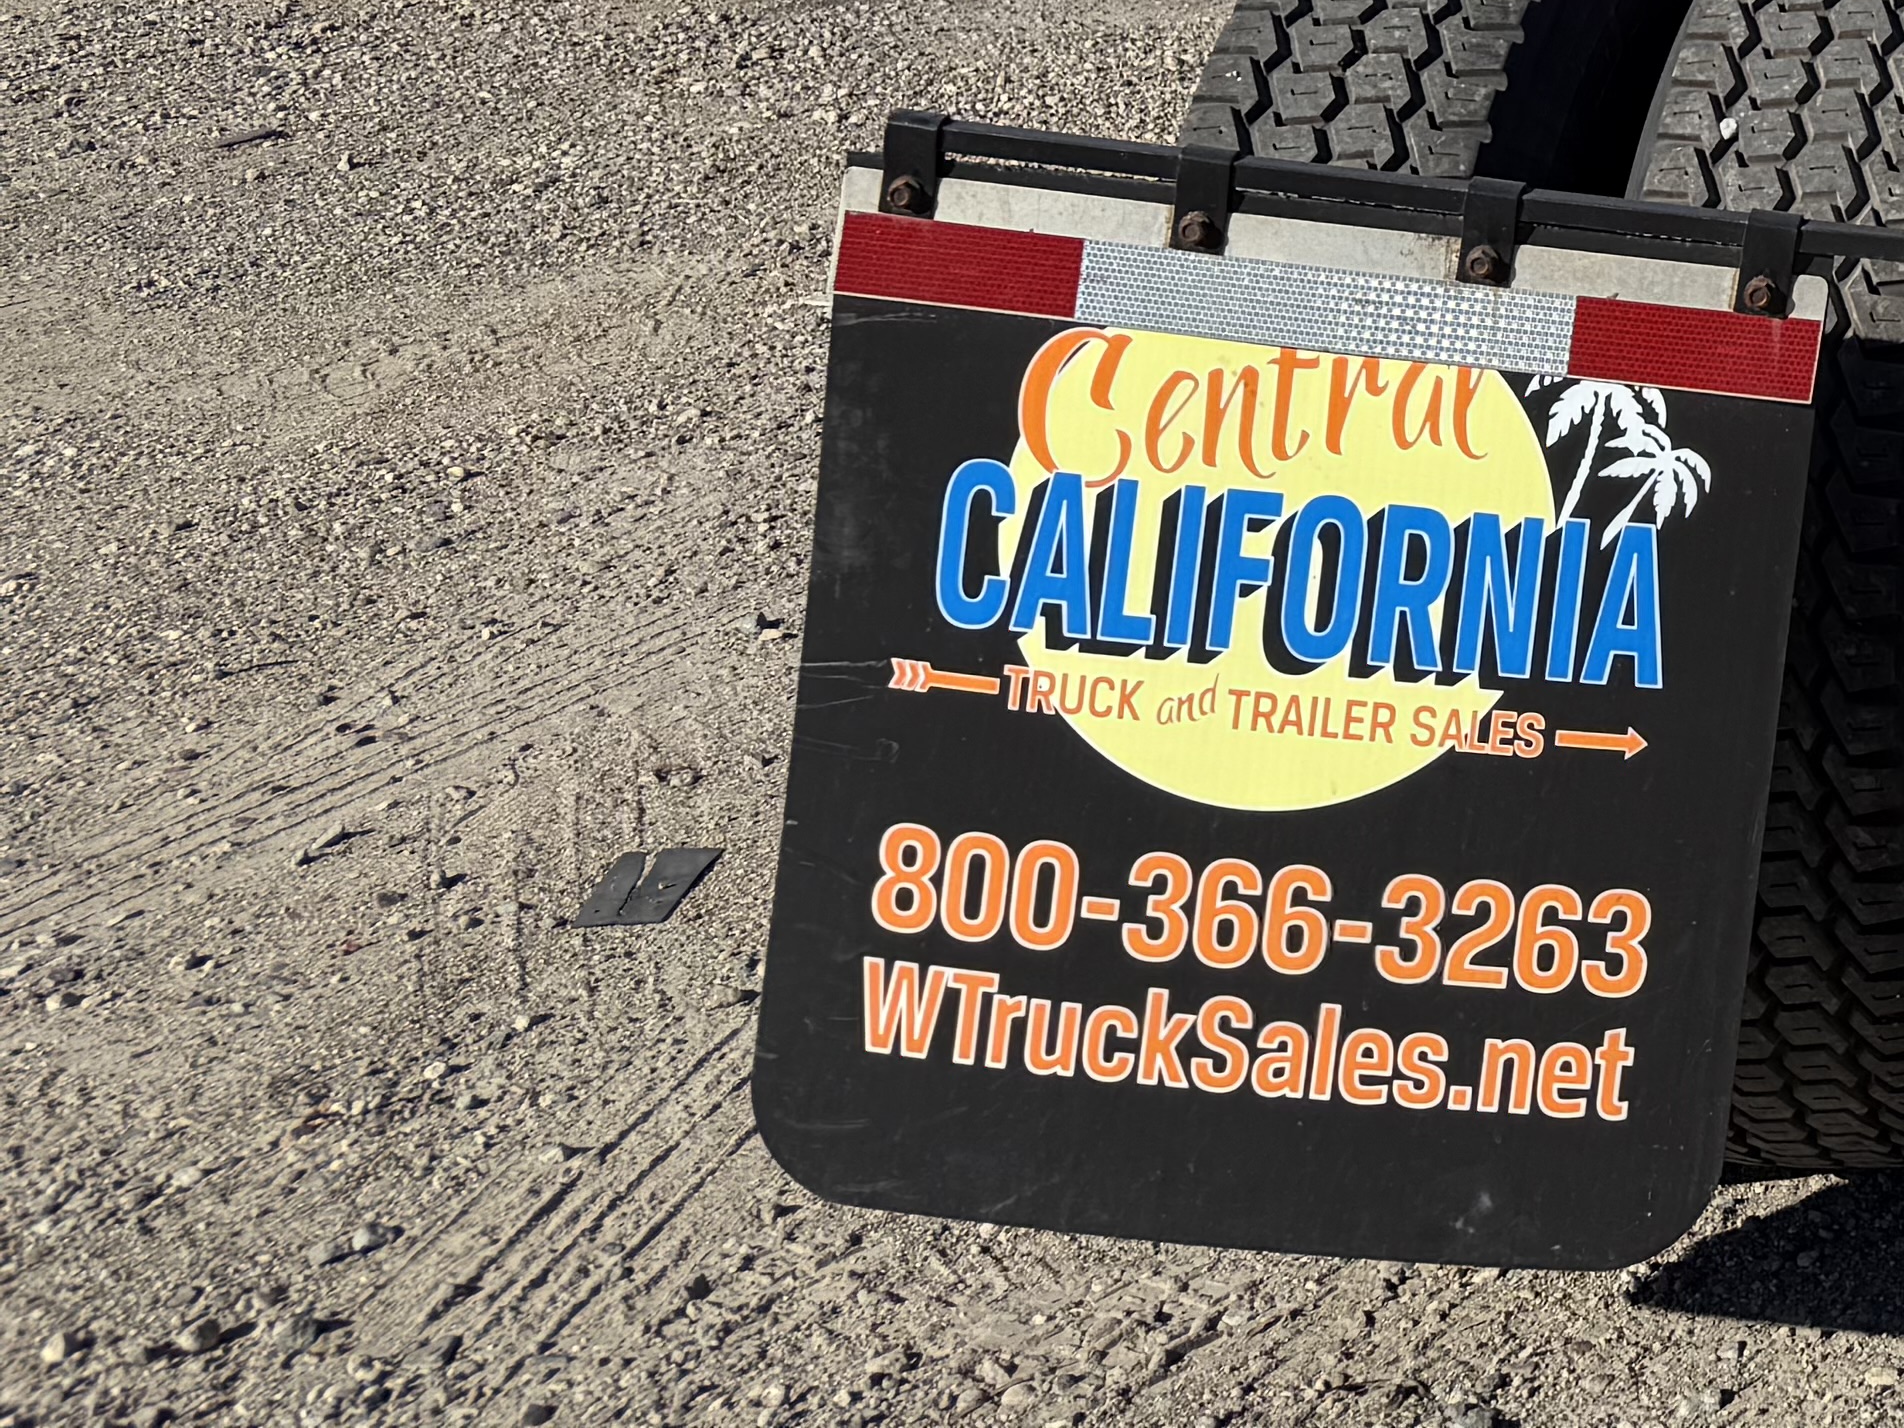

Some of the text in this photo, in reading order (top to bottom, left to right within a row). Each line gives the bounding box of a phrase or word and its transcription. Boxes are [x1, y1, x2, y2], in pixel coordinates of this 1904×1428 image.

[932, 457, 1664, 690] CALIFORNIA
[1002, 665, 1547, 760] TRUCK and TRAILER SALES
[870, 822, 1652, 999] 800-366-3263
[861, 956, 1635, 1122] WTruckSales.net
